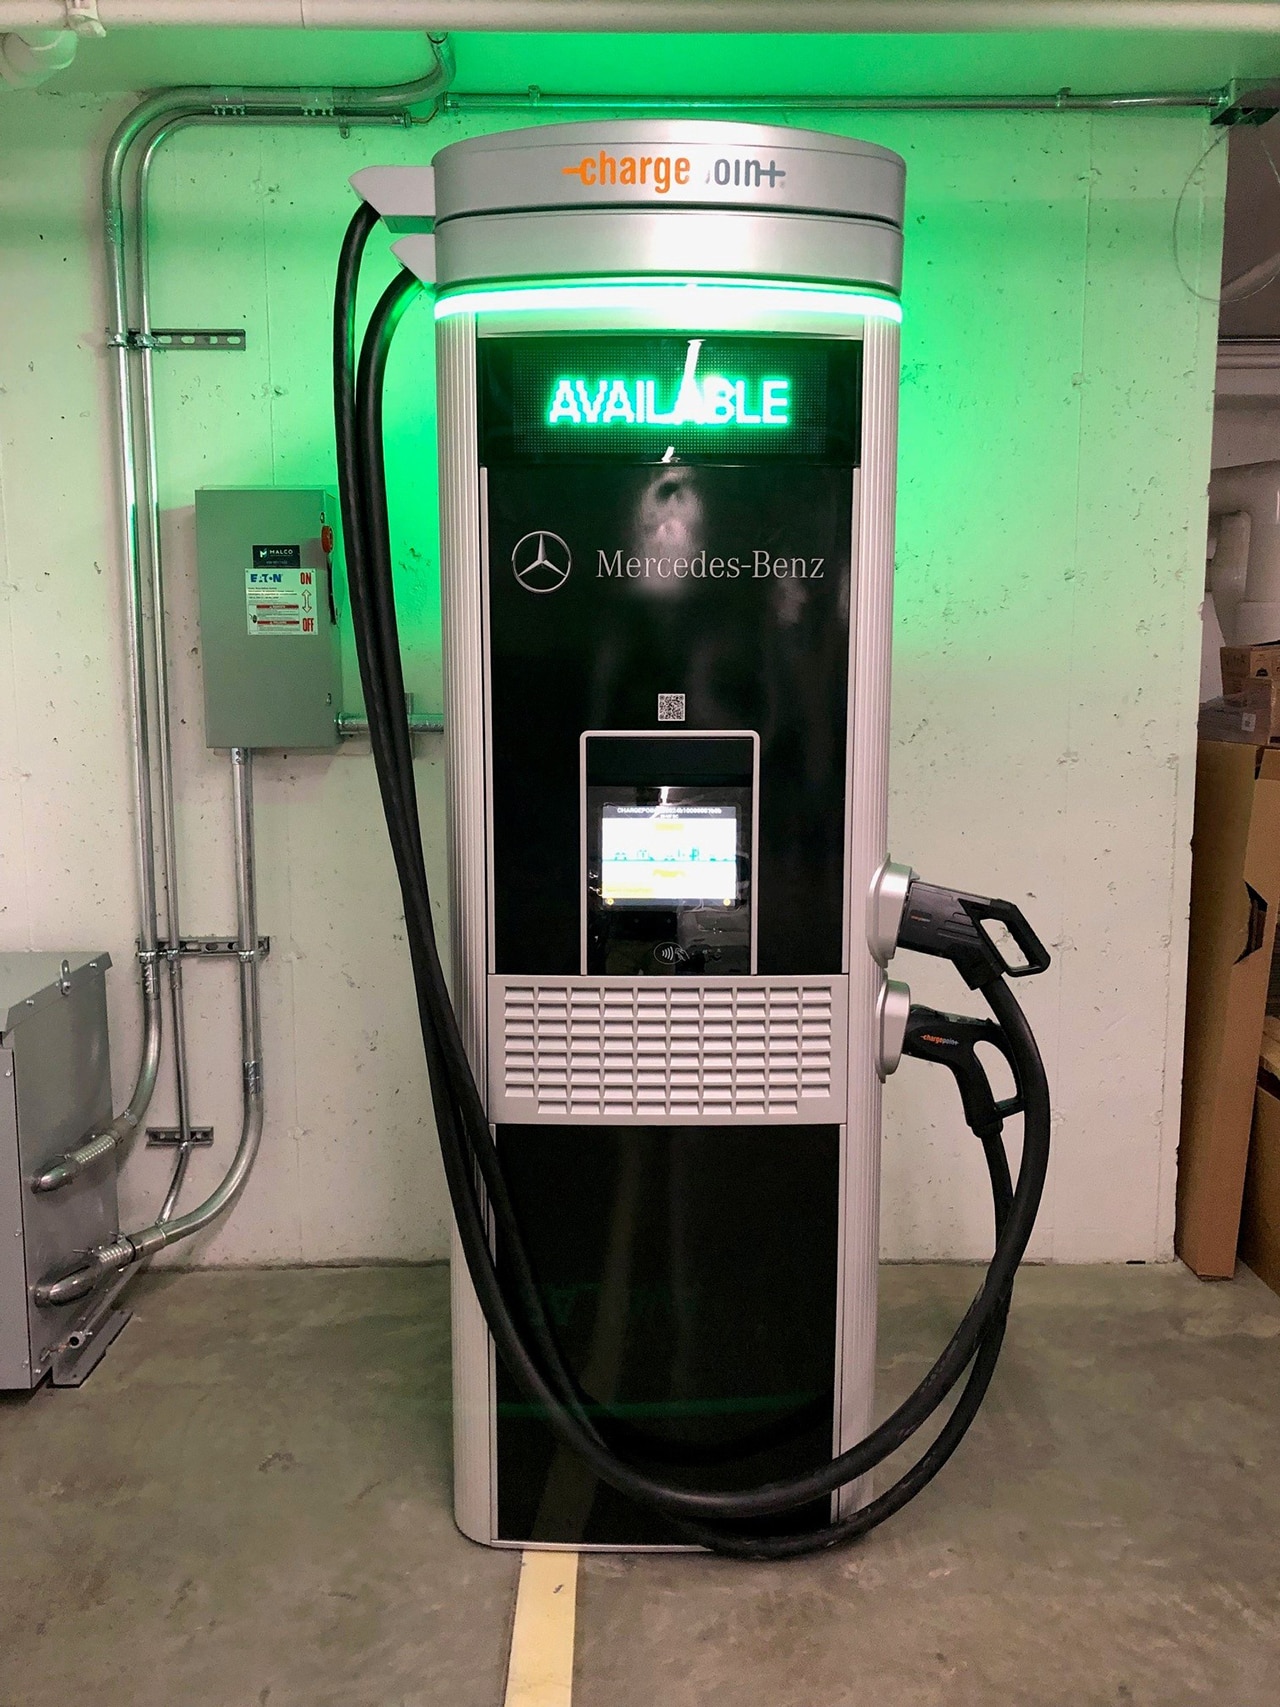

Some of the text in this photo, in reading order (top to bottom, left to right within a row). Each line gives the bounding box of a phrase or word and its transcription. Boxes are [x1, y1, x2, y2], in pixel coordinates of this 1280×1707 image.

[561, 150, 787, 194] chargeoint
[548, 379, 789, 425] AVAILABLE
[300, 572, 312, 585] ON
[595, 549, 825, 579] Mercedes-Benz
[302, 617, 314, 632] OFF
